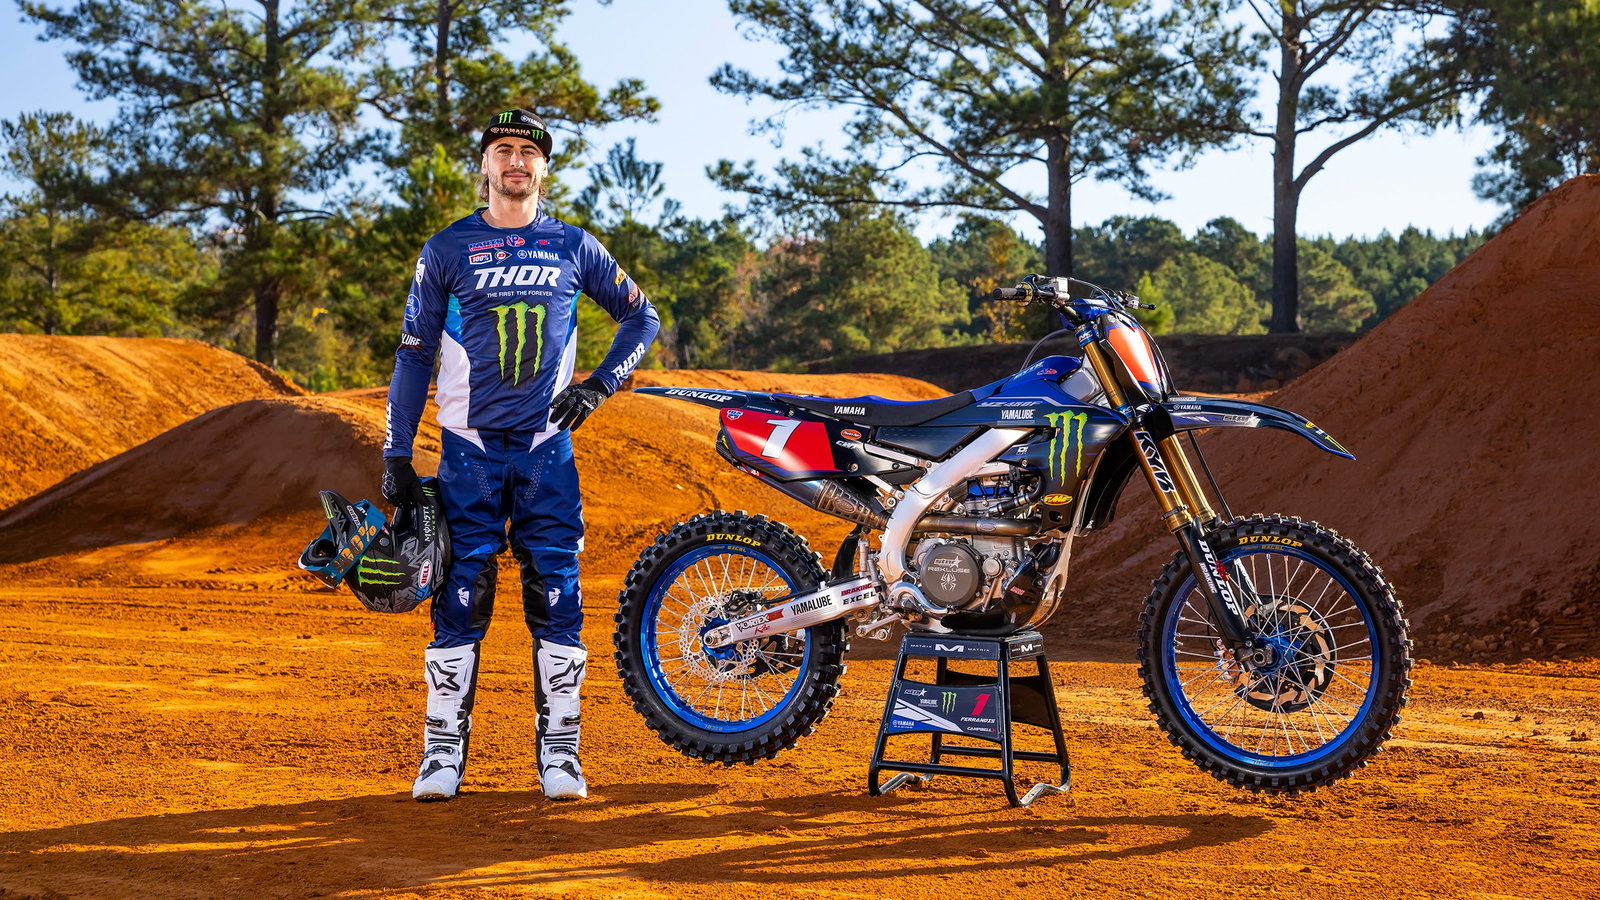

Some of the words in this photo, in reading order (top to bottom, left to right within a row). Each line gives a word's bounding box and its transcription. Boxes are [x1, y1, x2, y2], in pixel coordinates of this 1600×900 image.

[500, 127, 531, 135] YAMAHA
[473, 254, 489, 262] 100%
[527, 250, 560, 261] YAMAHA
[473, 265, 561, 290] THOR
[611, 342, 646, 380] THOR
[664, 388, 733, 403] DUNLOP
[834, 405, 866, 416] YAMAHA
[1001, 409, 1035, 420] YAMALUBE
[761, 419, 802, 459] 1
[1133, 430, 1176, 493] KYB
[1045, 495, 1073, 503] FMF
[706, 533, 761, 547] DUNLOP
[1238, 535, 1303, 548] DUNLOP
[420, 563, 430, 584] BELL
[927, 566, 970, 574] REKLUSE
[1198, 539, 1239, 616] DUNLOP
[841, 582, 873, 597] BRAKING
[790, 594, 833, 616] YAMALUBE
[842, 591, 877, 605] EXCEL
[735, 613, 770, 632] VORTEX
[971, 693, 991, 716] 1
